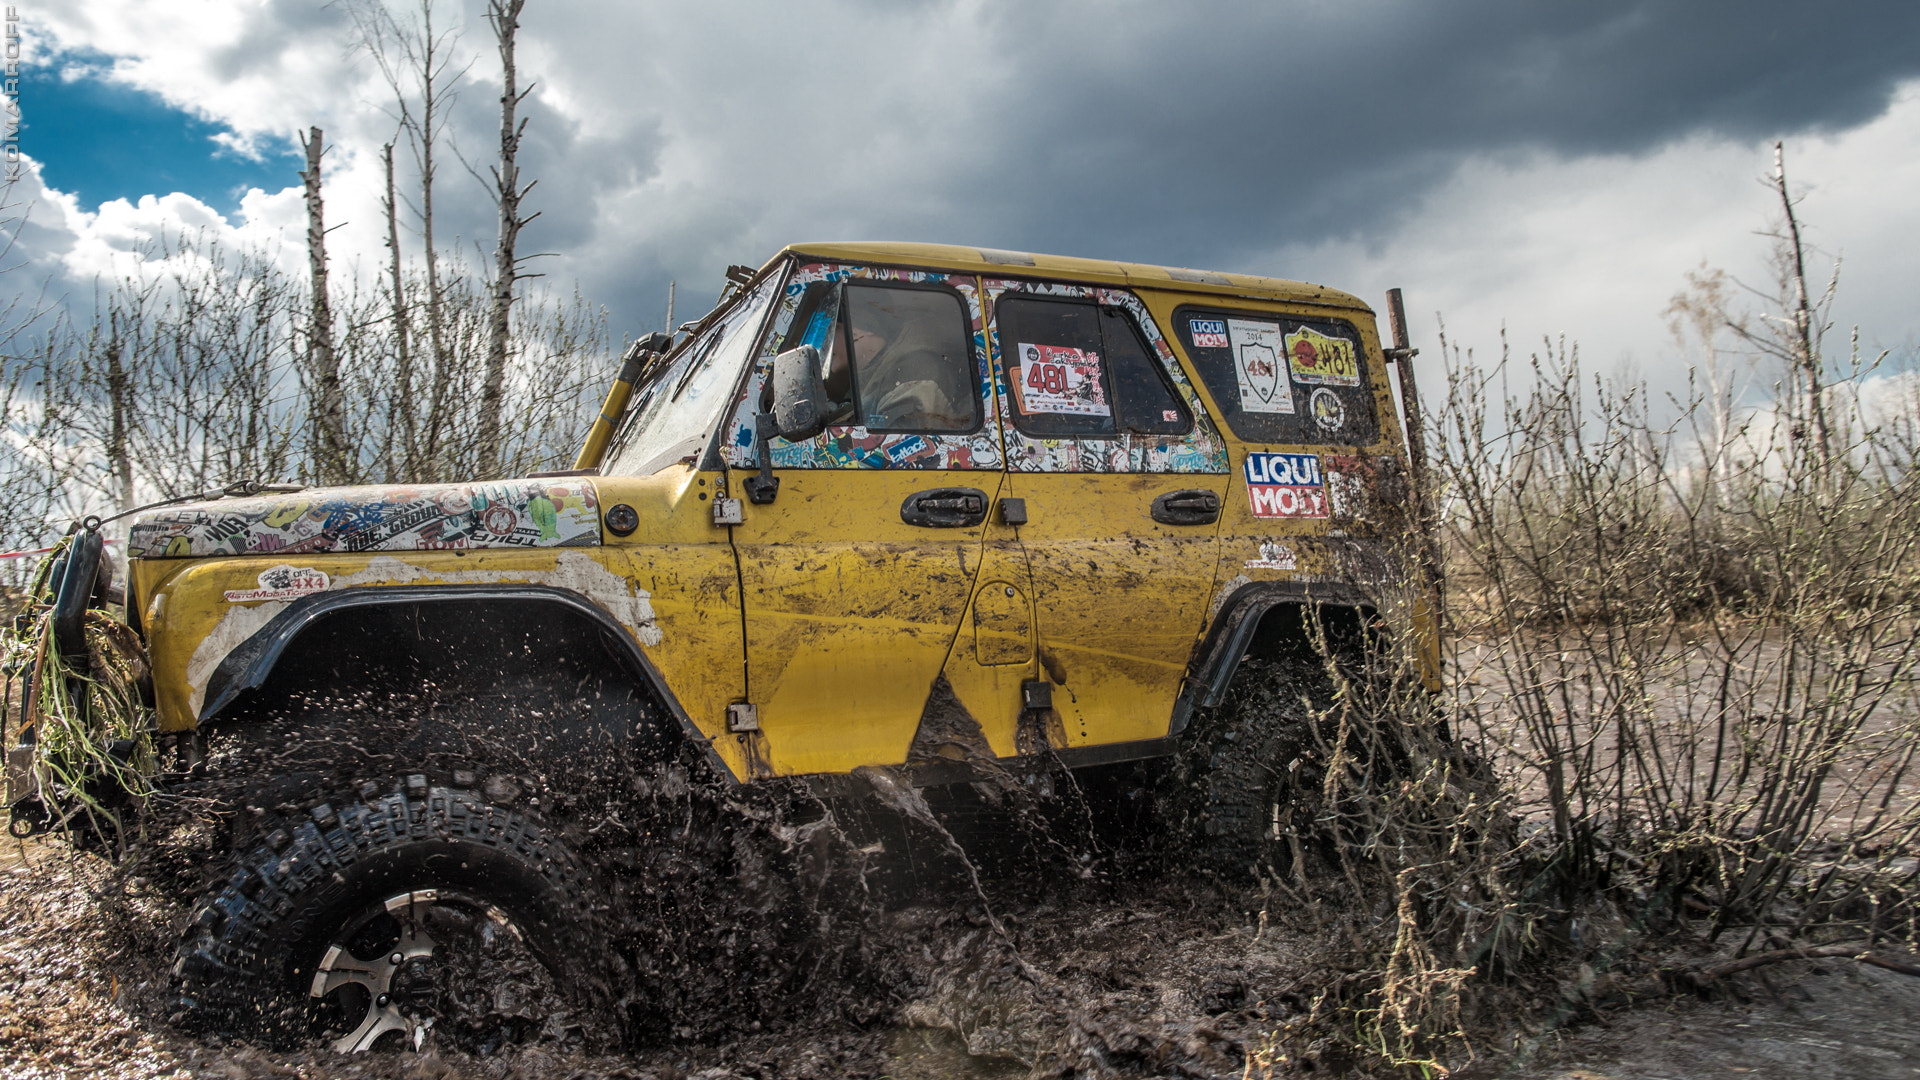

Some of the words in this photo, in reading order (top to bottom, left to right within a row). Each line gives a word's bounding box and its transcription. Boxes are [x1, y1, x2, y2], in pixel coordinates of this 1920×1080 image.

[1192, 321, 1224, 334] LIQUI
[1194, 333, 1227, 346] MOLY
[1247, 360, 1273, 378] 481
[1320, 341, 1352, 375] 481
[1027, 363, 1069, 394] 481
[1247, 456, 1320, 485] LIQUI
[1252, 487, 1323, 515] MOLY
[291, 577, 325, 590] 4X4
